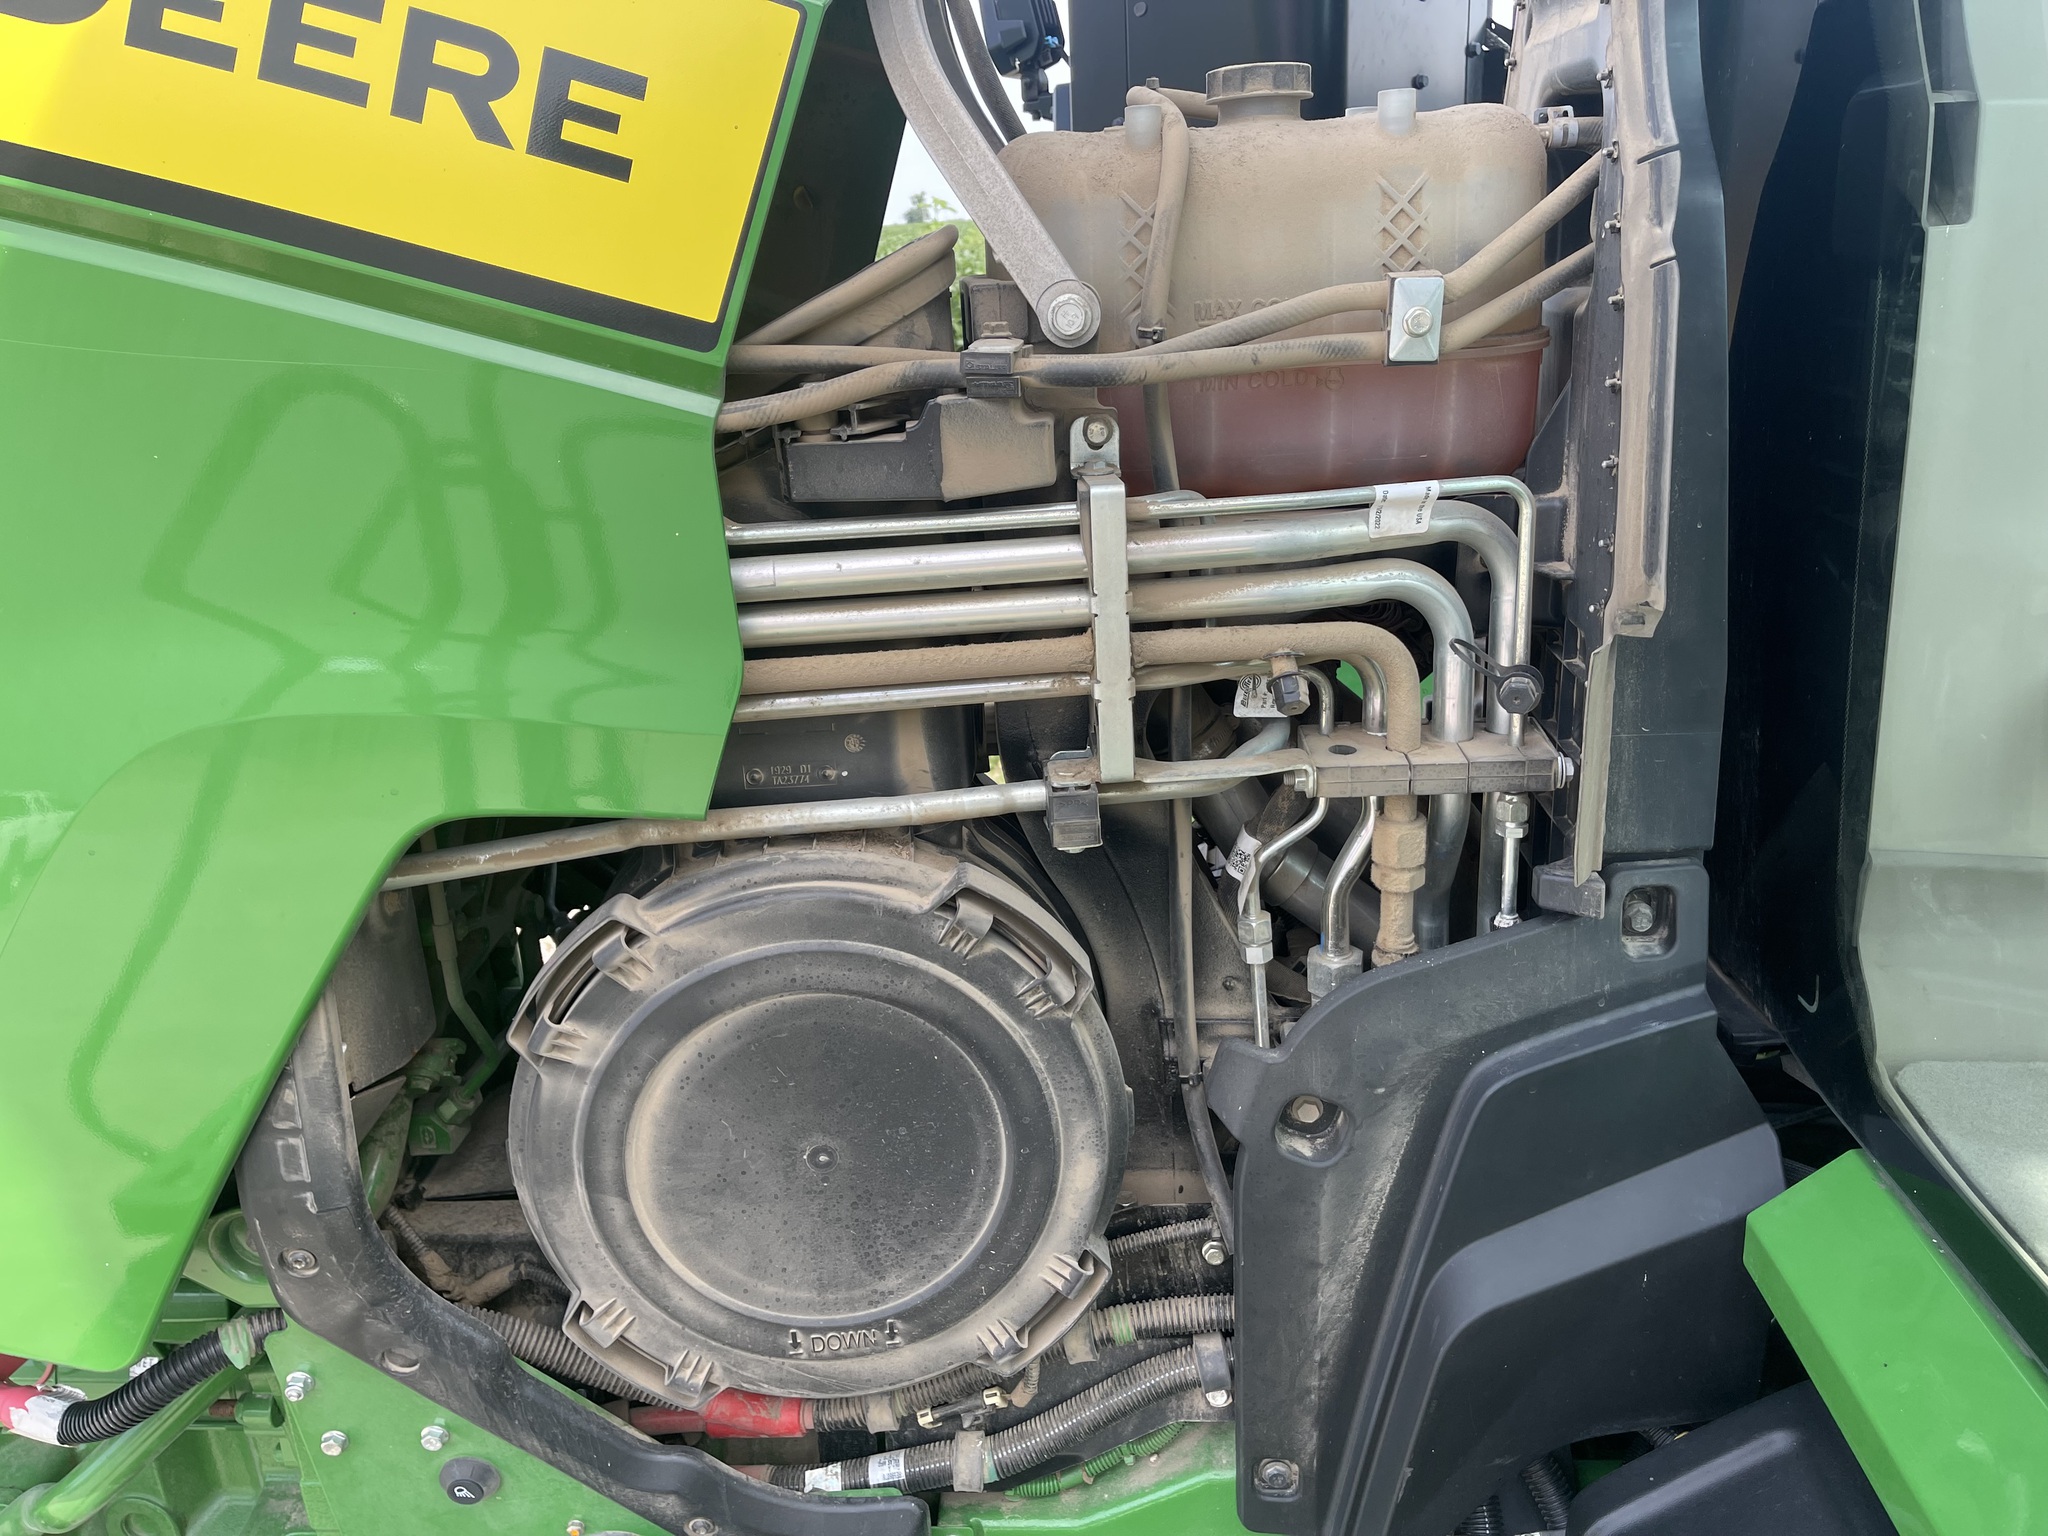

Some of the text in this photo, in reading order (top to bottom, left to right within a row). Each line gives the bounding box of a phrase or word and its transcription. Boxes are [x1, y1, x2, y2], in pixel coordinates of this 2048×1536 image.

[1200, 369, 1309, 392] MIN COLD
[770, 765, 792, 775] 1929
[810, 1329, 877, 1353] DOWN
